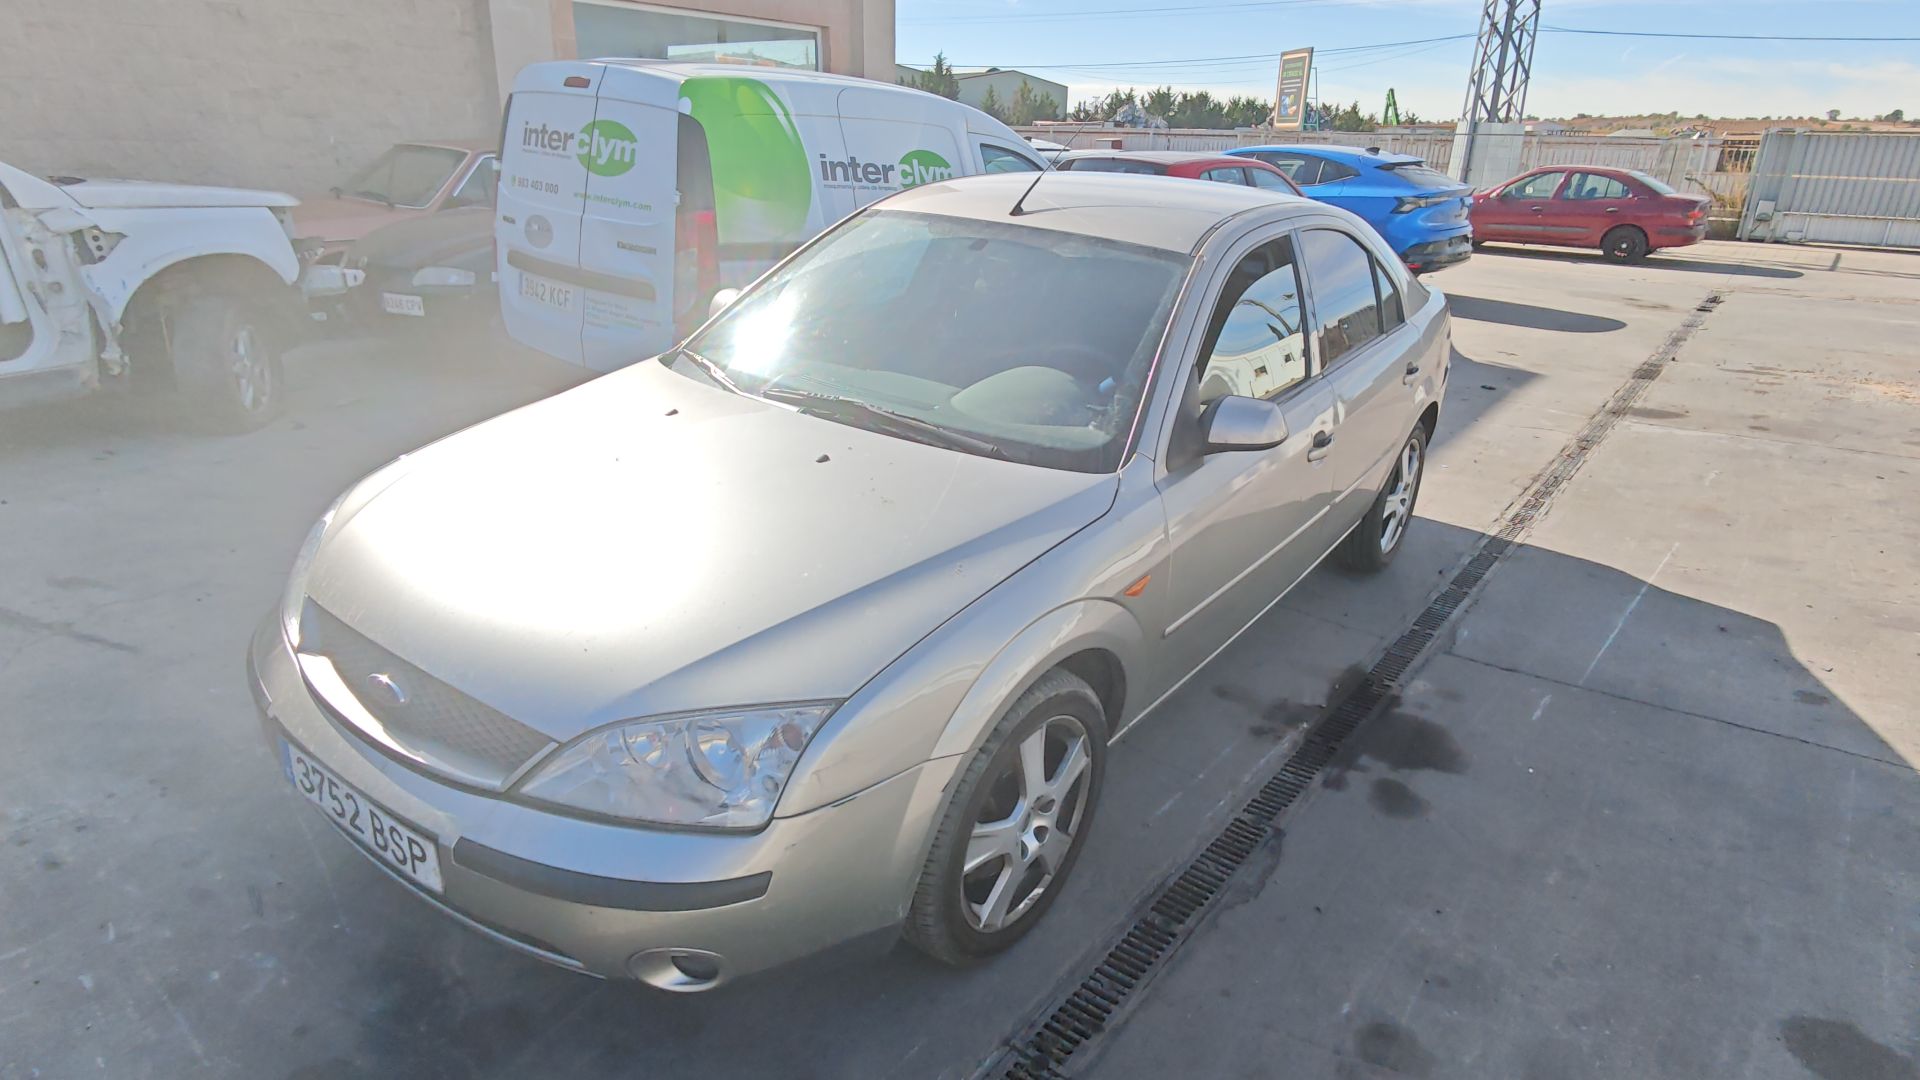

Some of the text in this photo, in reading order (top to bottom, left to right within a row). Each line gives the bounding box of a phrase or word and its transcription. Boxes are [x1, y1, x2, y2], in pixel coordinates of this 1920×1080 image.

[544, 182, 559, 194] 000
[549, 286, 571, 308] KCF
[297, 756, 427, 875] 3752 BSP
